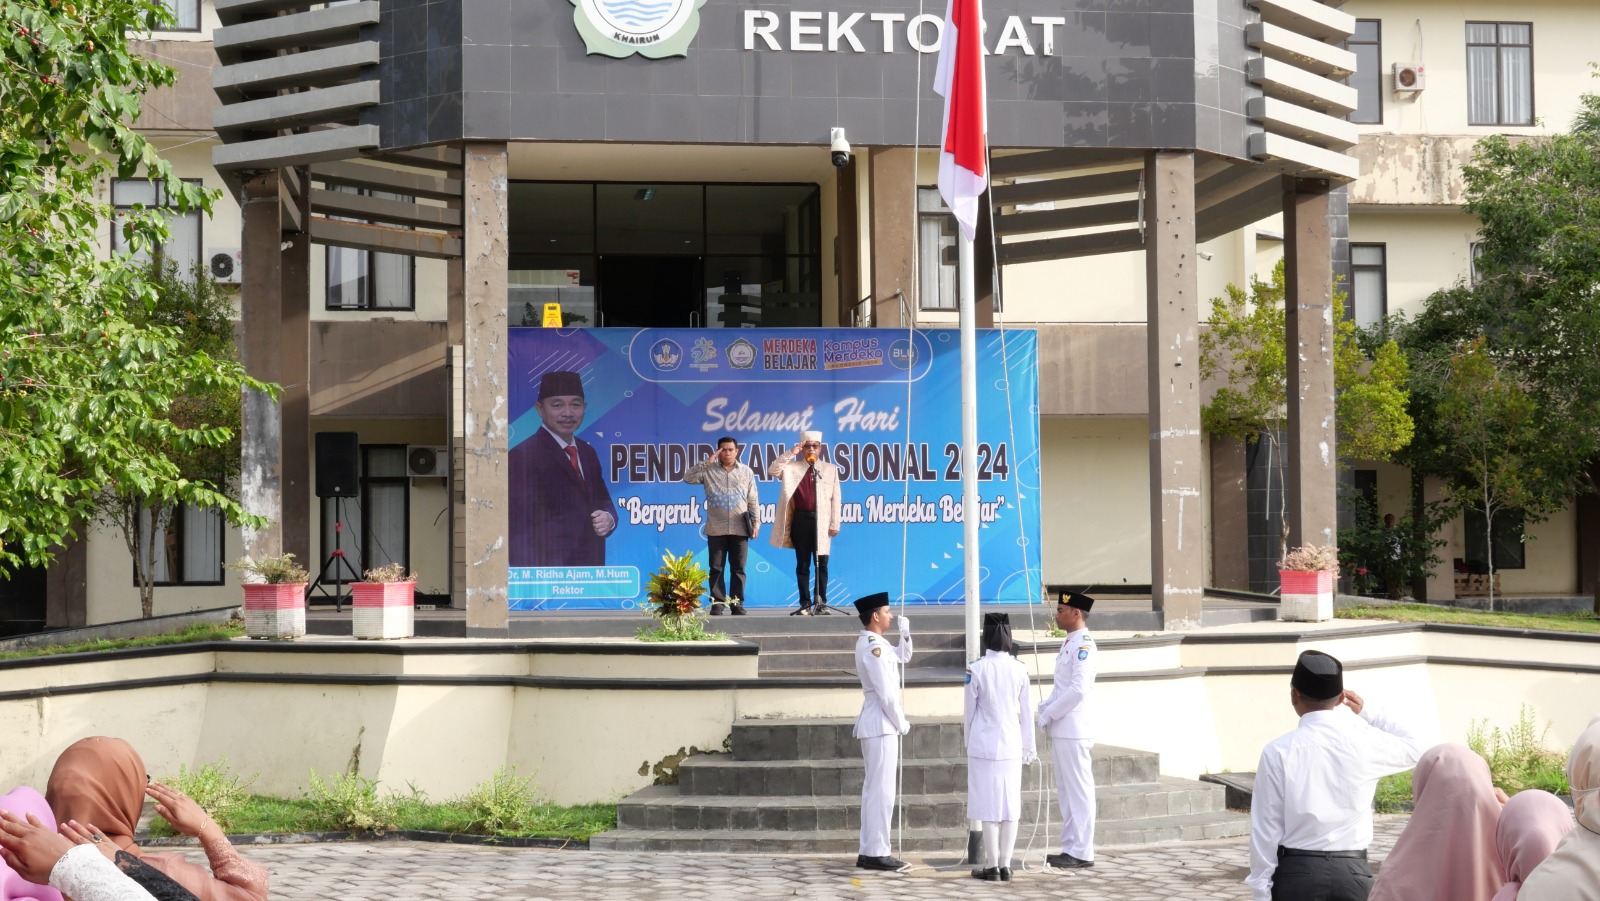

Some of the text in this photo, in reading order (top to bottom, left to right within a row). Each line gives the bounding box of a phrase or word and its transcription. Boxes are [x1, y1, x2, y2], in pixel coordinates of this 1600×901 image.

[613, 31, 661, 44] KHAIRUN
[762, 338, 818, 354] MERDEKA
[823, 338, 879, 352] Kampus
[763, 353, 818, 371] BELAJAR
[823, 348, 884, 363] Merdeka
[702, 396, 900, 432] Selamat Hari
[943, 442, 1009, 482] 224
[866, 494, 938, 524] Merdeka
[522, 569, 533, 579] M.
[535, 569, 564, 579] Ridha
[566, 569, 594, 580] Ajam,
[596, 568, 629, 579] M.Hum
[552, 585, 585, 595] Rektor
